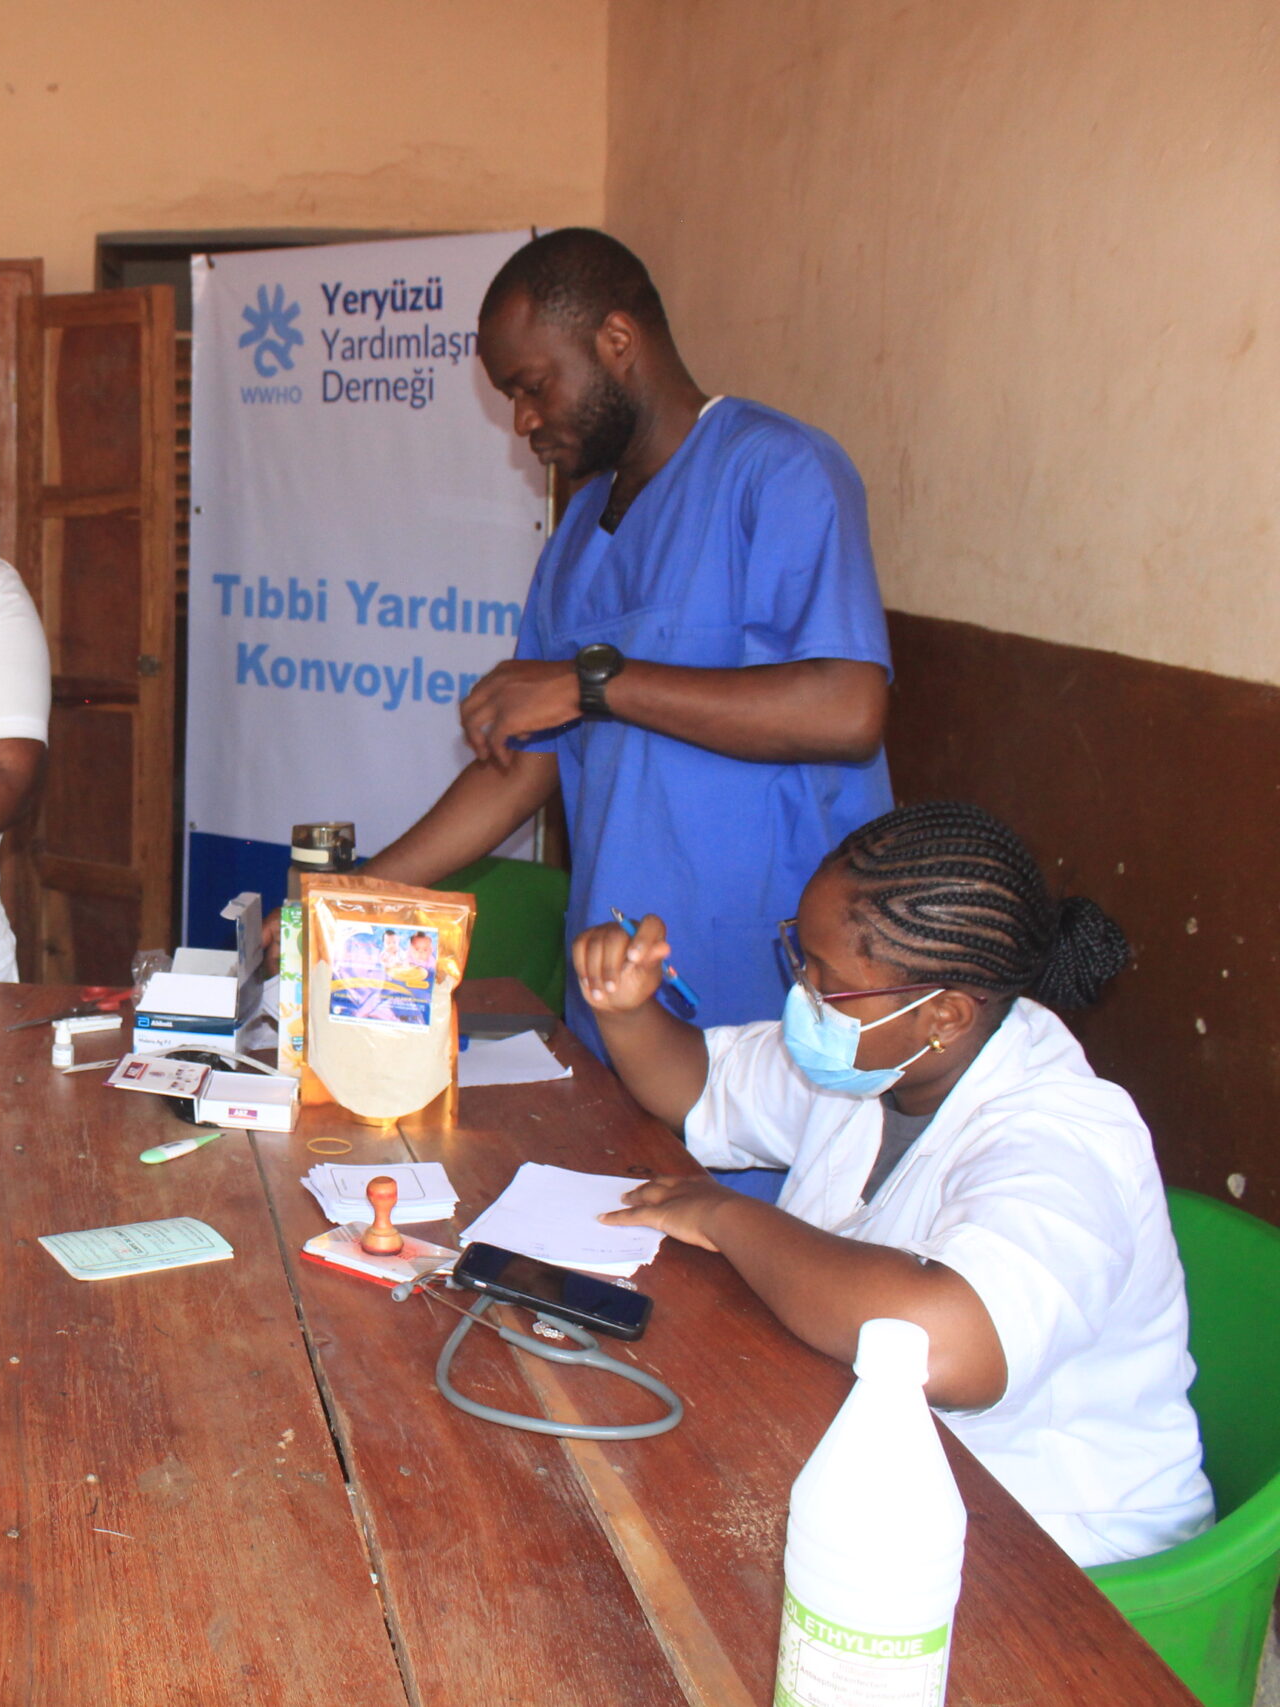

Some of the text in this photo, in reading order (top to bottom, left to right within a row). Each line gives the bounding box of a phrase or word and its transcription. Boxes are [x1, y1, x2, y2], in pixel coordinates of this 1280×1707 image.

[321, 277, 443, 320] Yeryüzü
[240, 385, 303, 404] WWHO
[322, 368, 434, 410] Derneği
[212, 573, 520, 637] Tıbbi Yardım
[804, 1615, 924, 1656] ETHYLIQUE
